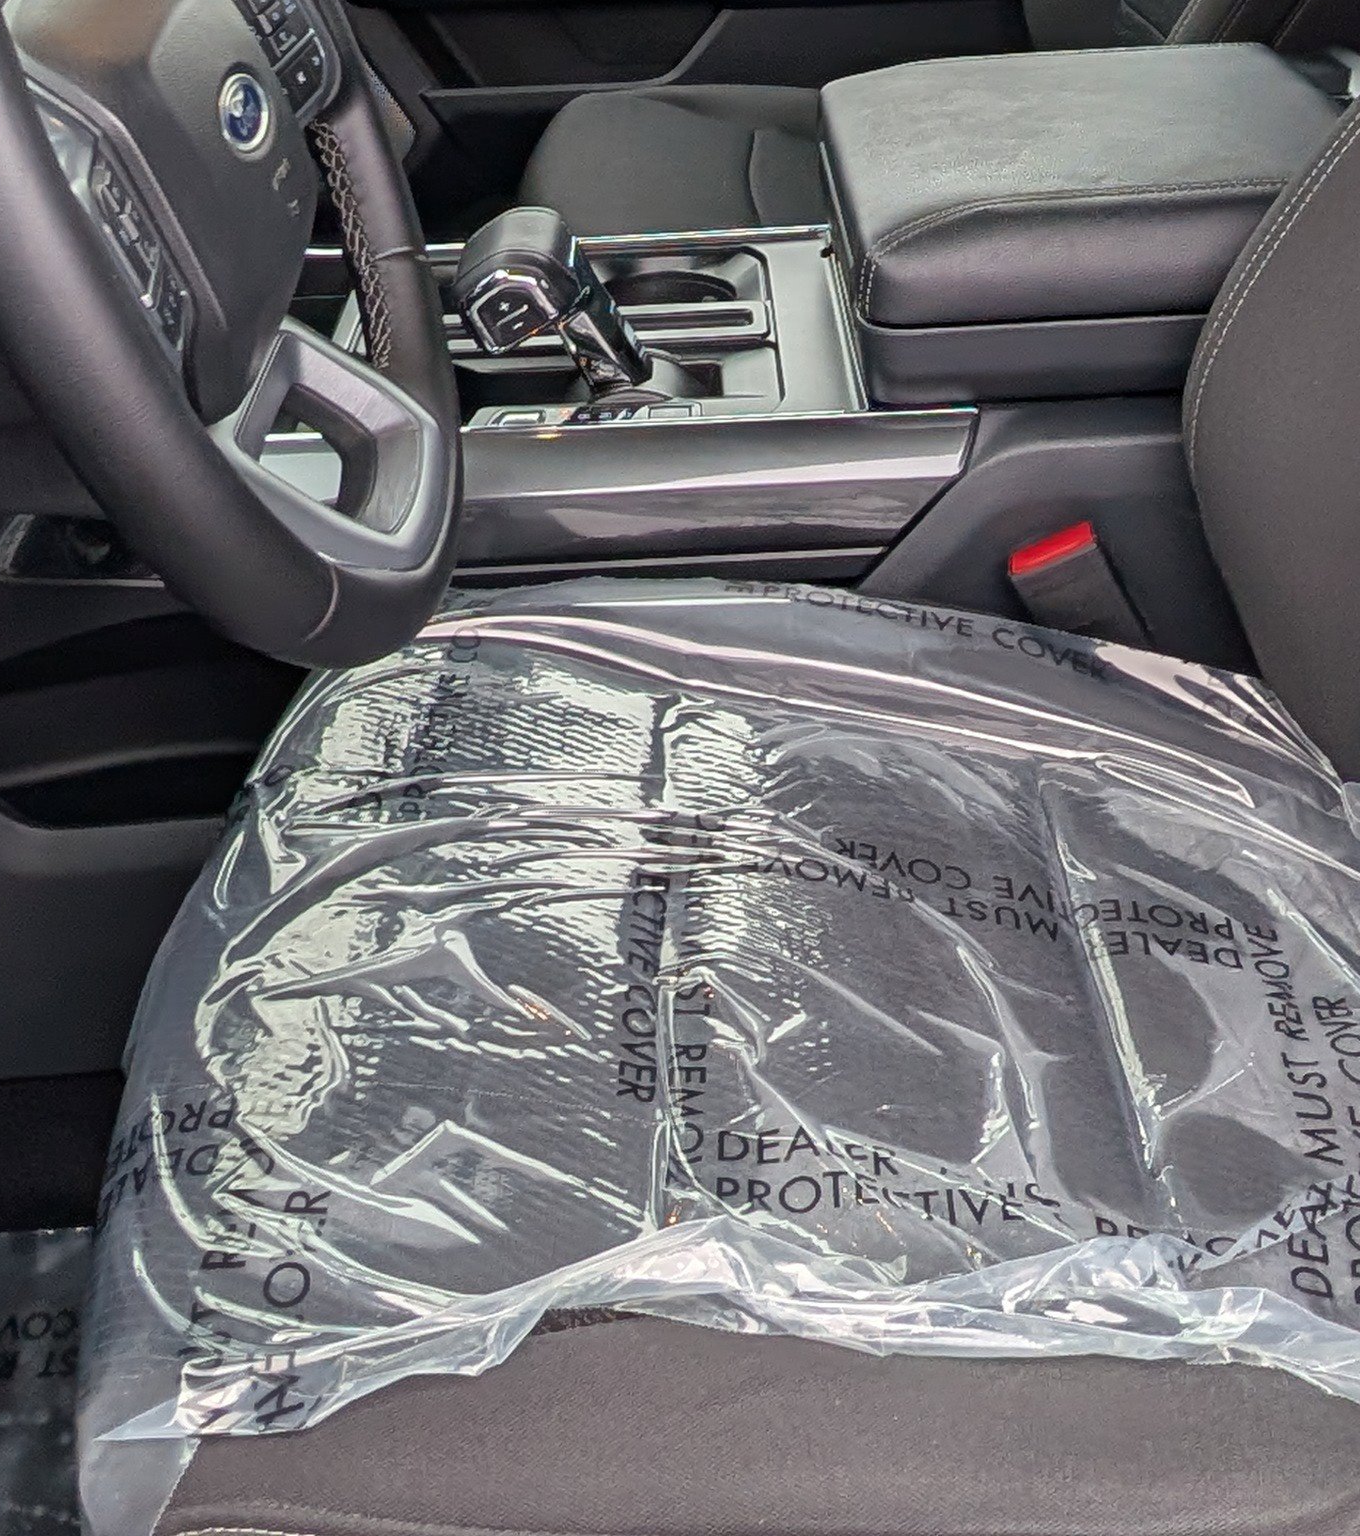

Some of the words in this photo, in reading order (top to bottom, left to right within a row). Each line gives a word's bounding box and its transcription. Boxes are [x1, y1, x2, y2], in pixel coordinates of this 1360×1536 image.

[835, 837, 972, 891] COVER
[942, 896, 1058, 942] MUST
[992, 874, 1234, 941] PROTECTIVE
[1094, 929, 1243, 970] DEALE
[1243, 921, 1310, 1042] REMOVE
[615, 984, 657, 1104] COVER
[1281, 1051, 1344, 1166] MUST
